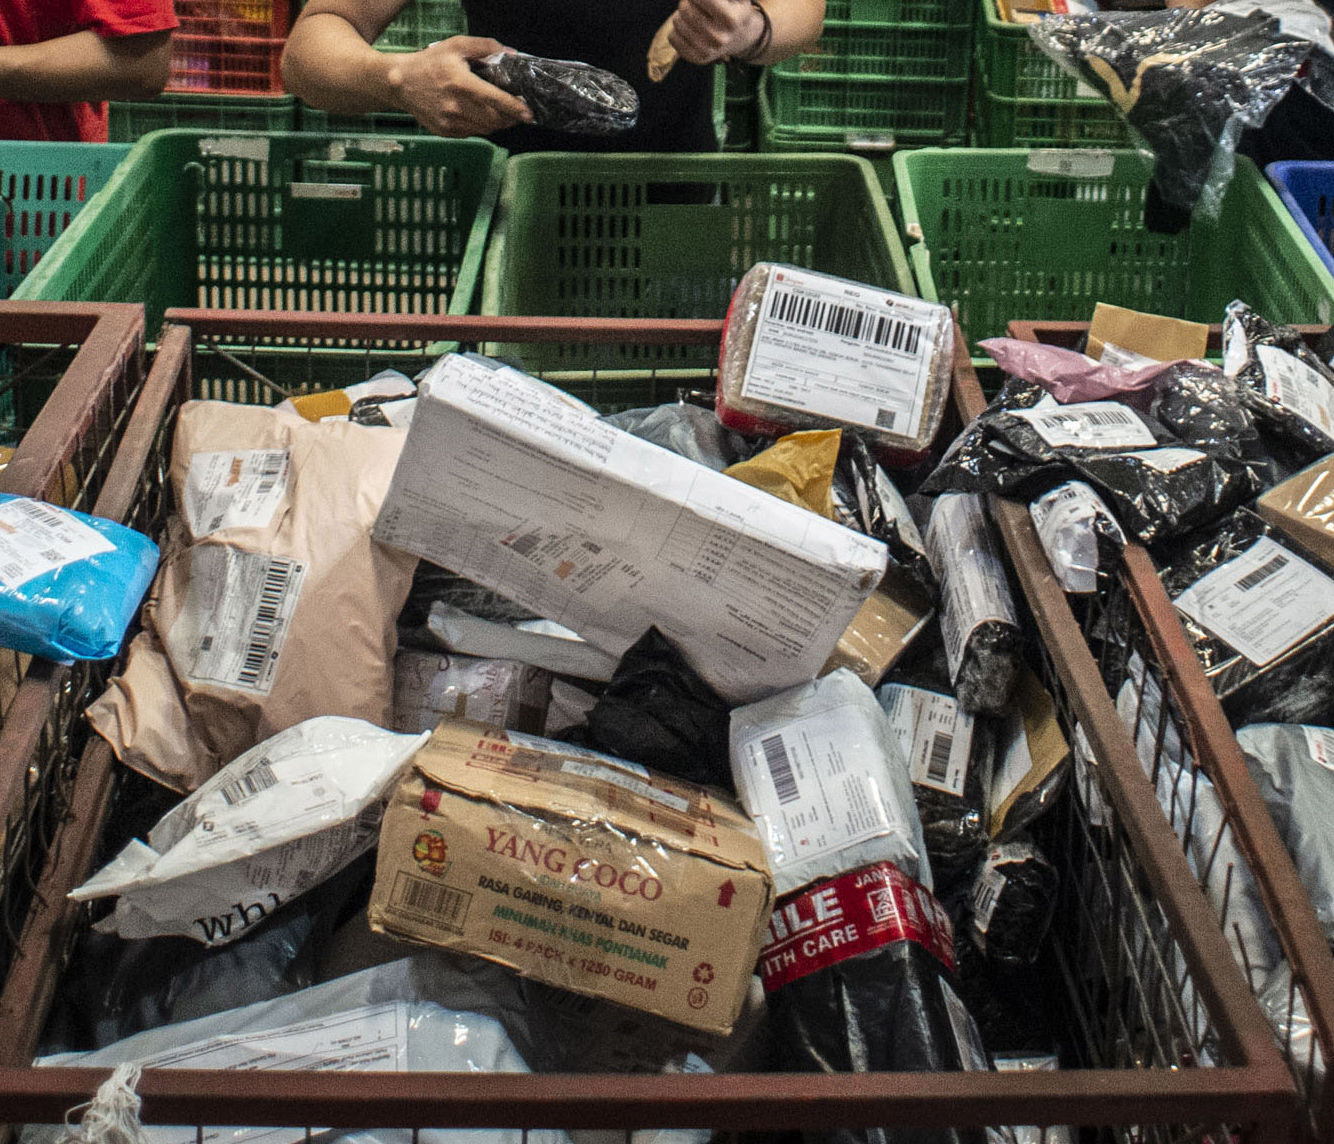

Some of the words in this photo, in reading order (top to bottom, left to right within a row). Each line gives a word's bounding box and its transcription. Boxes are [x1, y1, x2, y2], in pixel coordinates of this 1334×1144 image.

[485, 827, 567, 874] YANG
[570, 857, 663, 902] COCO
[478, 875, 510, 896] RASA
[618, 919, 646, 939] DAN
[649, 928, 690, 952] SEGAR
[802, 923, 860, 958] CARE
[489, 928, 510, 946] ISI:
[514, 937, 524, 950] 4
[525, 939, 566, 963] PACK
[613, 968, 658, 992] GRAM
[596, 937, 669, 970] PONTIANAK
